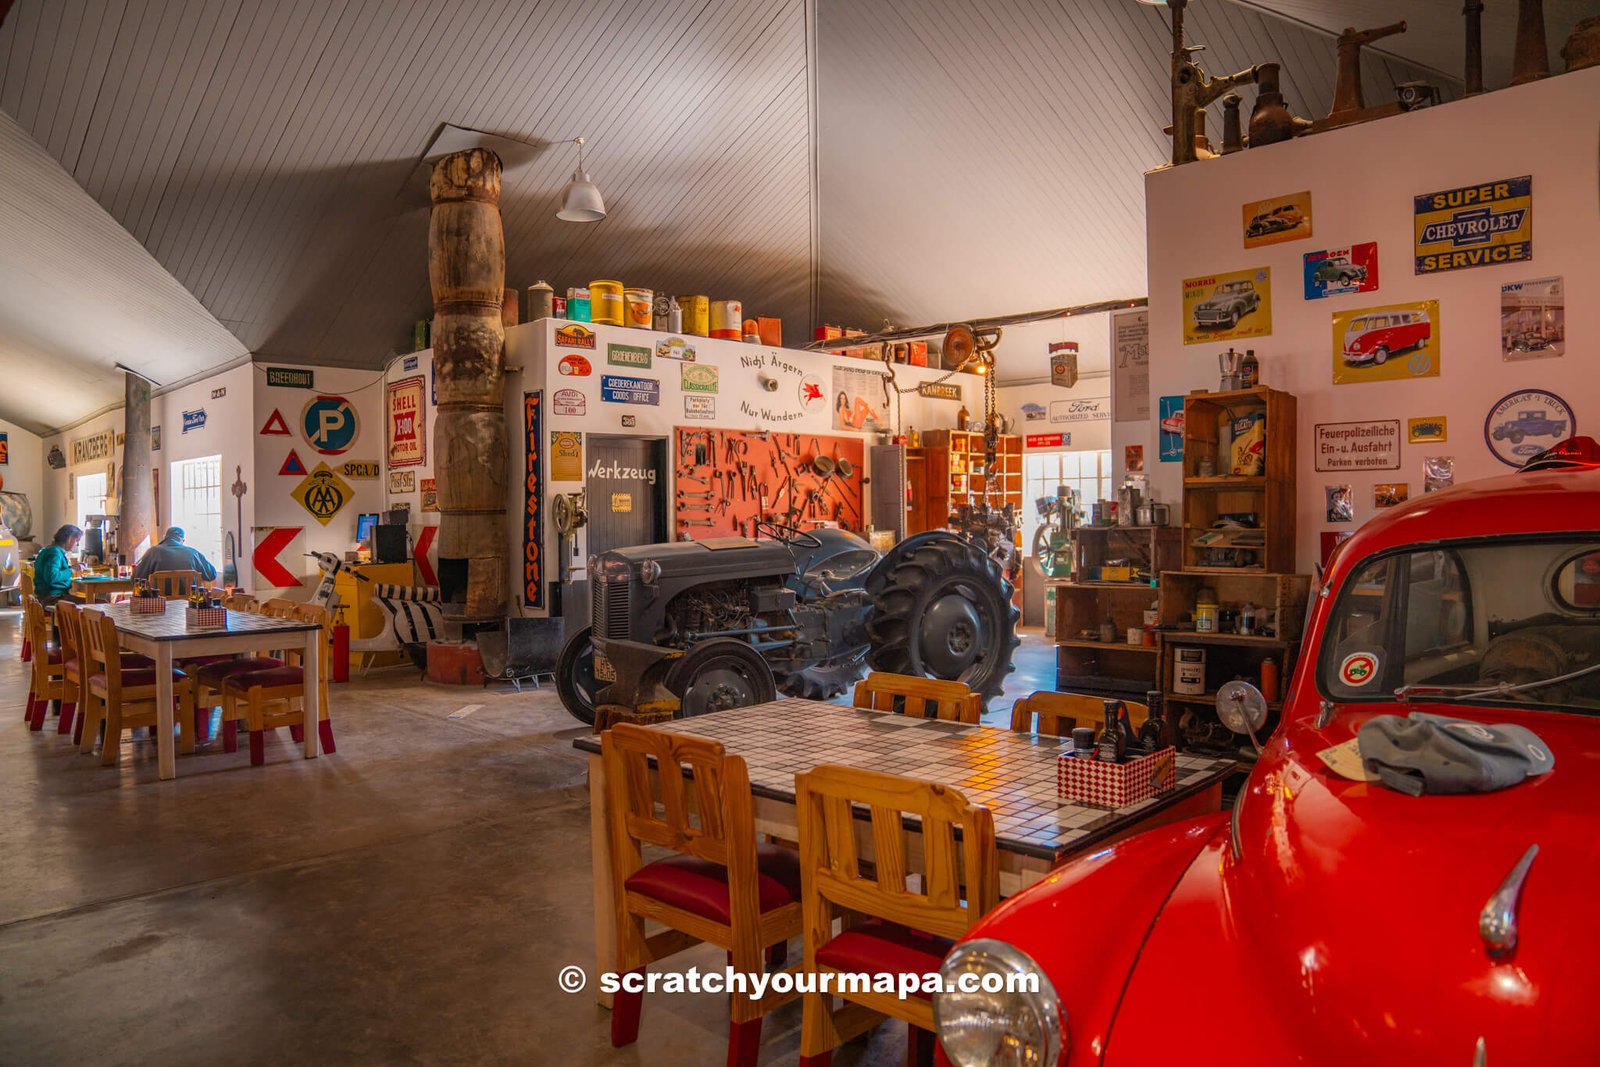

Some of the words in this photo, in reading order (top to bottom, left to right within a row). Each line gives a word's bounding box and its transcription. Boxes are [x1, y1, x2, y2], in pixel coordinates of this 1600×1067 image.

[1432, 183, 1510, 209] SUPER
[1425, 213, 1520, 240] CHEVROLET
[1423, 244, 1523, 271] SERVICE
[1184, 278, 1217, 289] MORRIS
[1501, 283, 1524, 293] DKW
[392, 394, 417, 412] SHELL
[740, 401, 759, 418] Nur
[760, 408, 803, 421] Wundern
[1068, 400, 1100, 413] Ford
[319, 409, 345, 442] P
[1319, 425, 1395, 441] Feuerpolizeiliche
[73, 433, 109, 464] KRANZBERG
[1350, 440, 1393, 453] Ausfahrt
[1327, 457, 1353, 467] Parken
[1354, 456, 1388, 466] verboten
[588, 459, 657, 485] Werkzeug
[524, 397, 540, 603] Firestone
